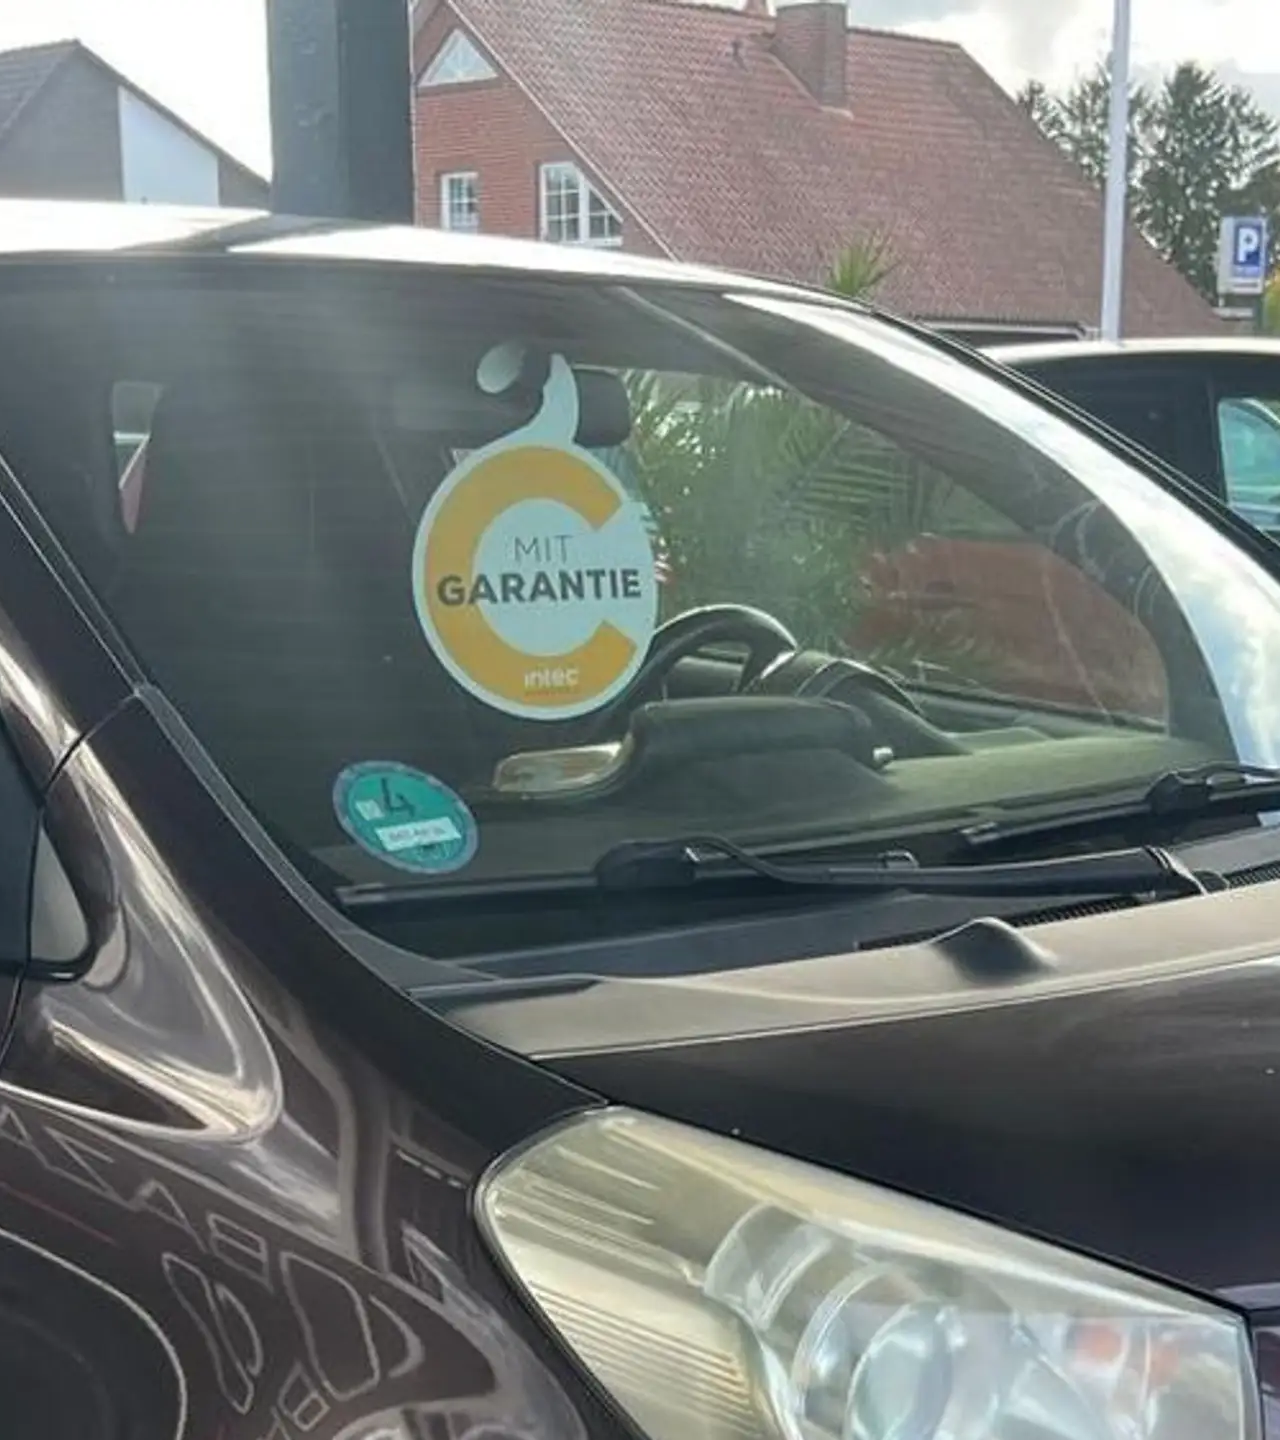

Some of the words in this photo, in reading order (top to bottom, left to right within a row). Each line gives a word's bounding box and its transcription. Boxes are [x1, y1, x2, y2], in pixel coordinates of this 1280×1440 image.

[1237, 227, 1260, 263] P
[513, 535, 575, 562] MIT
[436, 568, 643, 606] GARANTIE
[380, 776, 416, 816] 4
